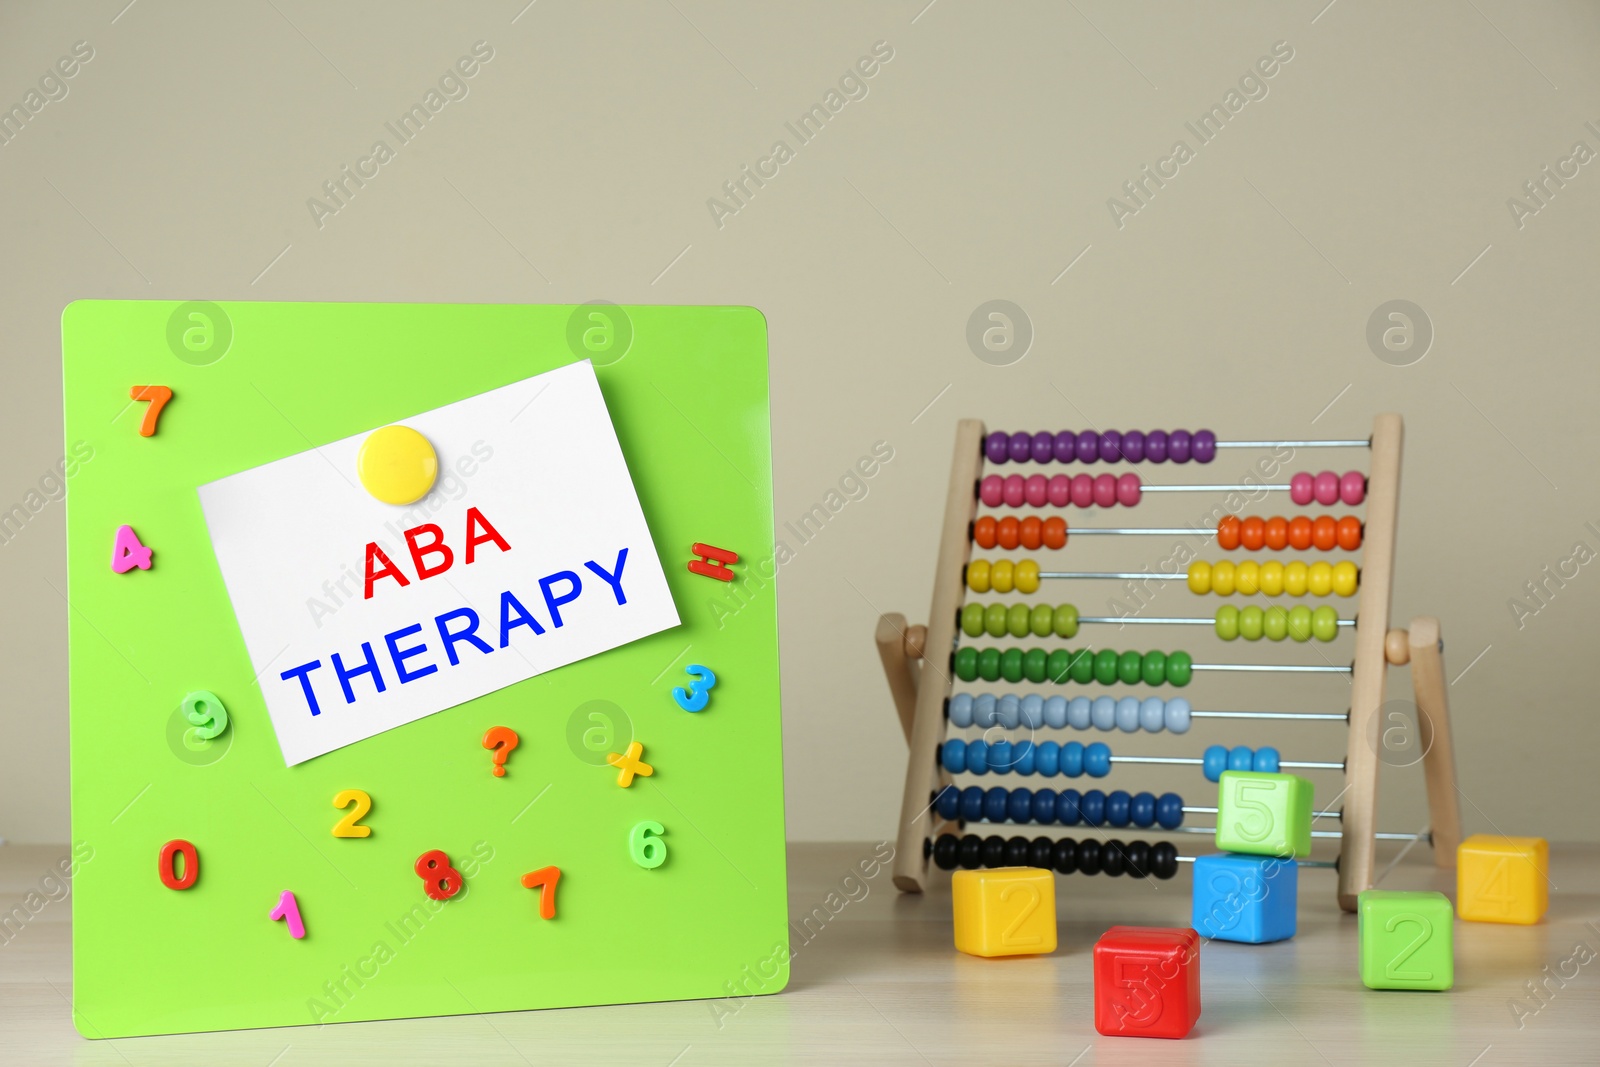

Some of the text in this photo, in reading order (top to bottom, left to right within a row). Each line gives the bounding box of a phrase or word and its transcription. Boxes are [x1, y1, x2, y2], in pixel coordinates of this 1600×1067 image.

[130, 386, 172, 437] 7
[112, 525, 153, 575] 4
[364, 507, 511, 599] ABA
[280, 548, 628, 716] THERAPY
[671, 663, 717, 713] 3
[181, 690, 228, 740] 9
[482, 726, 519, 778] ?
[333, 791, 371, 839] 2
[1234, 780, 1276, 842] 5
[629, 821, 667, 869] 6
[414, 849, 463, 901] 8
[521, 866, 561, 921] 7
[1208, 870, 1242, 932] 8
[1474, 856, 1516, 917] 4
[270, 891, 306, 940] 1
[1000, 882, 1043, 947] 2
[1385, 913, 1433, 981] 2
[1114, 956, 1164, 1028] 5
